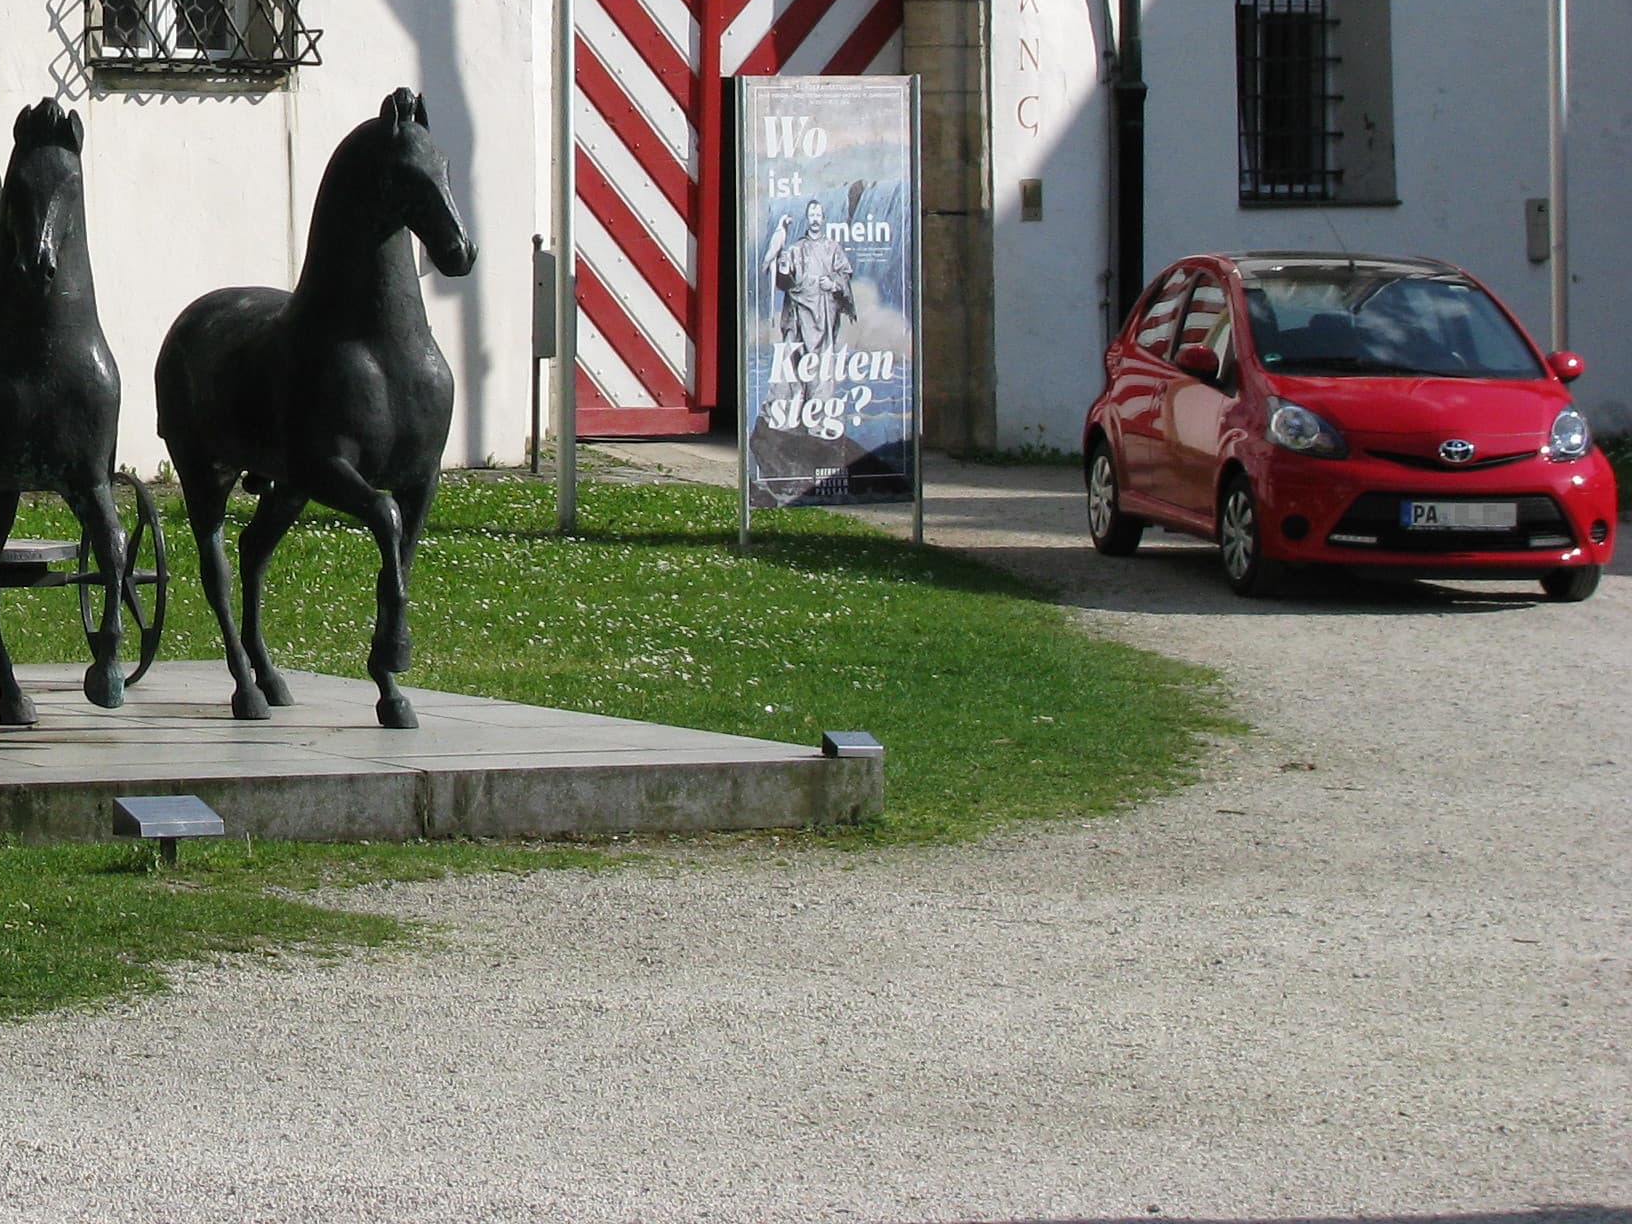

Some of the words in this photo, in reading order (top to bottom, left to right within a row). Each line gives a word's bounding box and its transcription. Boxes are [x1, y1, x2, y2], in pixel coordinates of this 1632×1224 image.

[763, 116, 828, 159] Wo
[768, 170, 803, 198] ist
[825, 214, 891, 243] mein
[768, 342, 894, 384] Ketten
[768, 385, 873, 441] steg?
